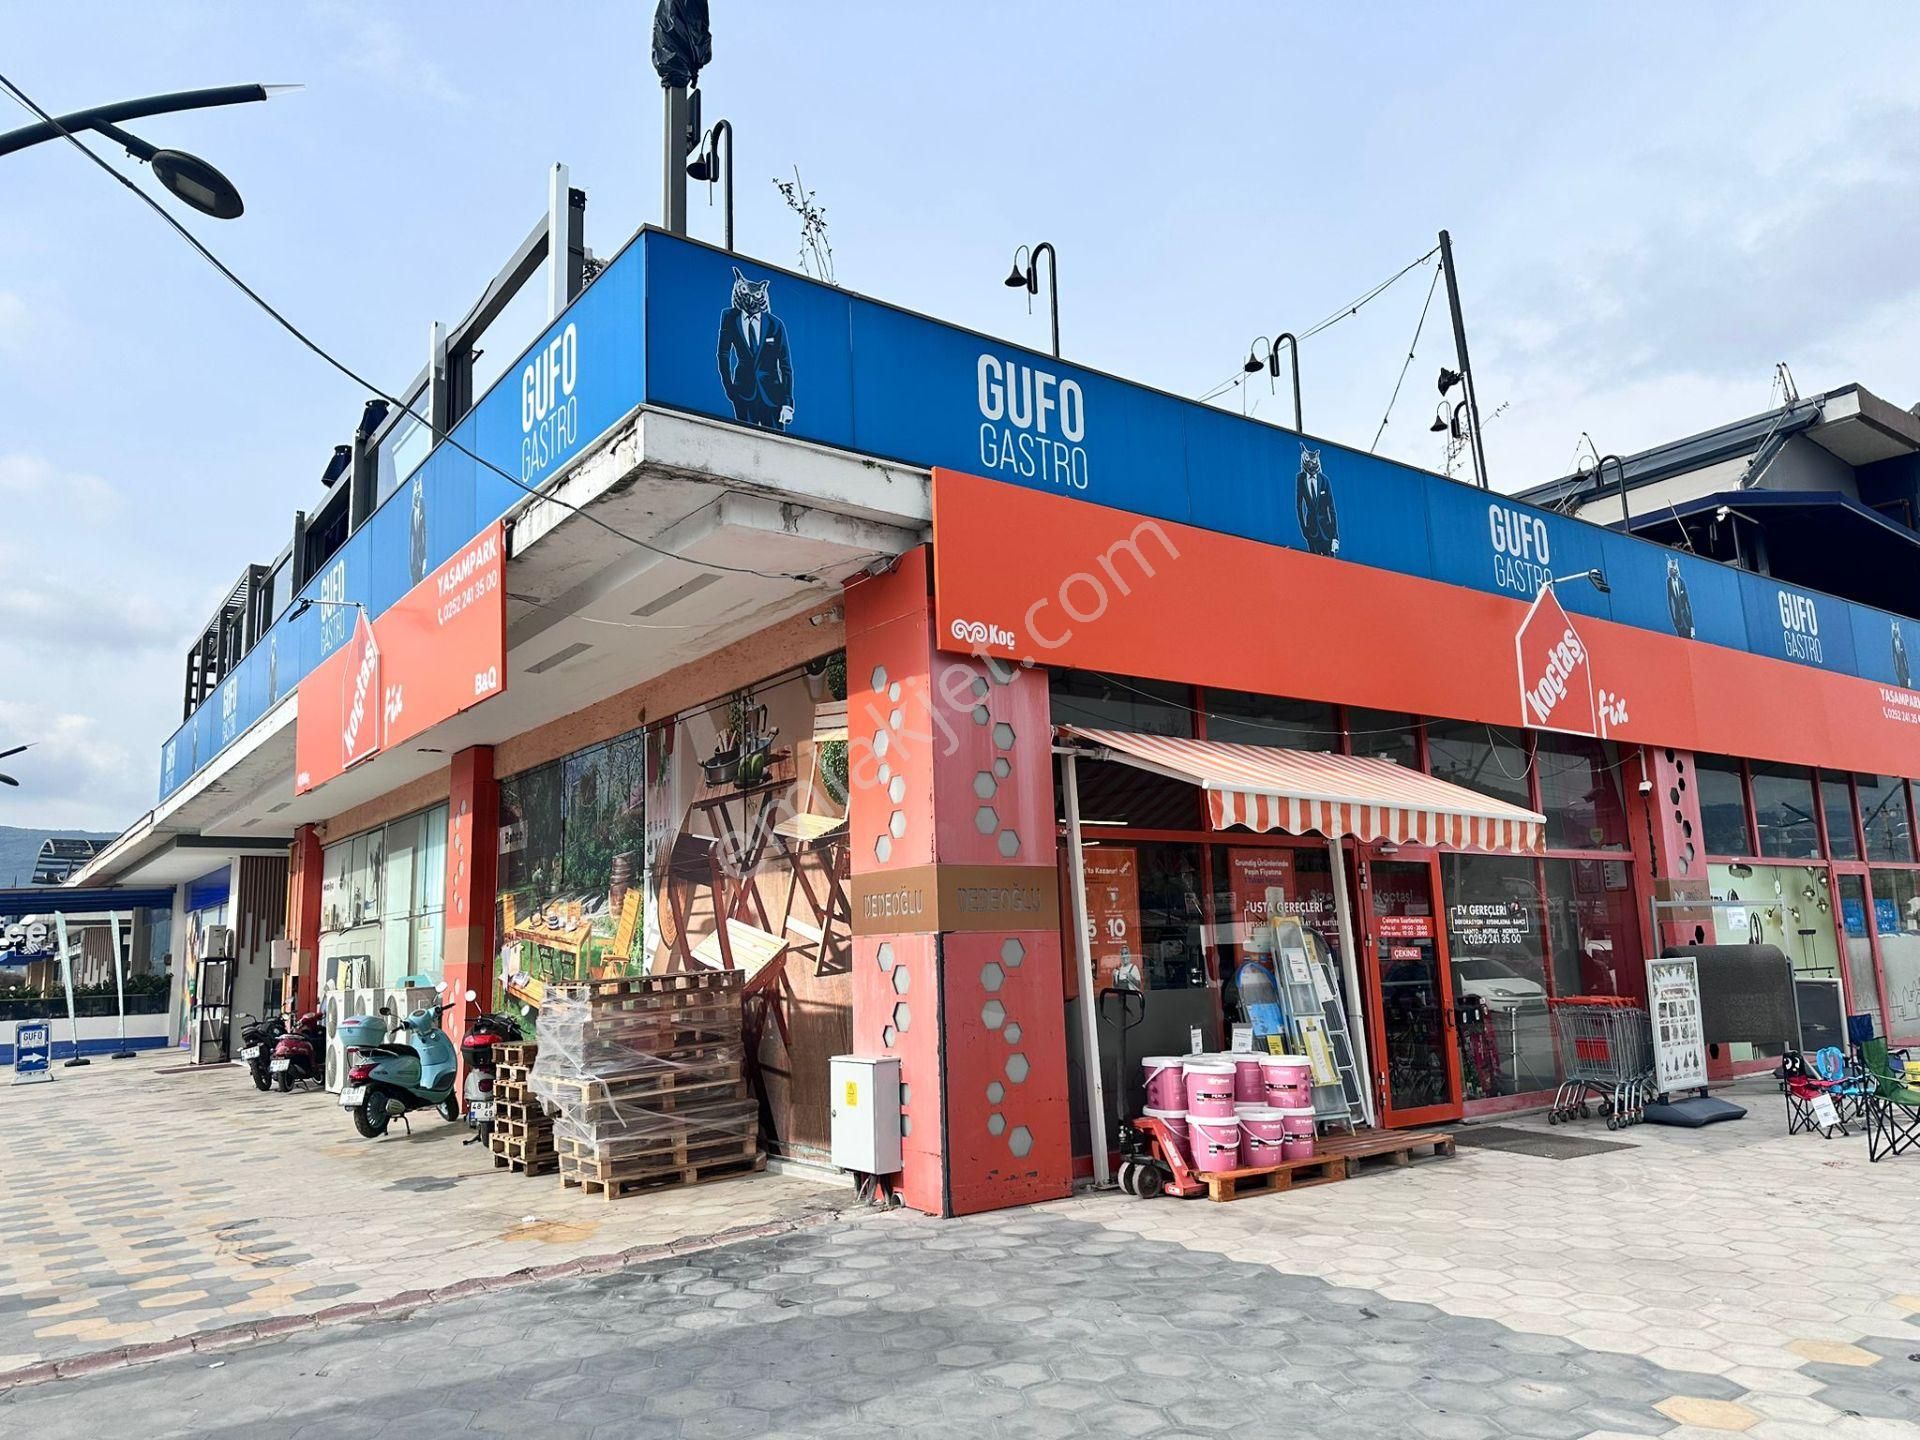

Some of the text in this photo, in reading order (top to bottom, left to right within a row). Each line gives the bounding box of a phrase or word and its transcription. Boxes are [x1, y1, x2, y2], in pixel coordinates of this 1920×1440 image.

[522, 322, 577, 433] GUFO
[978, 354, 1085, 443] GUFO
[522, 396, 577, 483] GASTRO
[980, 423, 1088, 490] GASTRO
[1488, 504, 1550, 565] GUFO
[437, 535, 498, 597] YAŞAMPARK
[320, 559, 345, 623] GUFO
[443, 569, 498, 622] 0252 241 35 00
[1778, 590, 1818, 636] GUFO
[320, 607, 345, 656] GASTRO
[988, 624, 1015, 650] Koç
[1783, 630, 1823, 664] GASTRO
[1599, 689, 1629, 740] fix
[863, 885, 923, 919] DEDEOĞLU
[957, 882, 1042, 913] DEDEOĞLU
[1249, 902, 1275, 913] USTA
[1456, 901, 1507, 918] EV GEREÇLERİ
[1468, 933, 1522, 945] 0252 241 35 00
[23, 1030, 43, 1041] GUFO
[472, 1101, 482, 1110] 48
